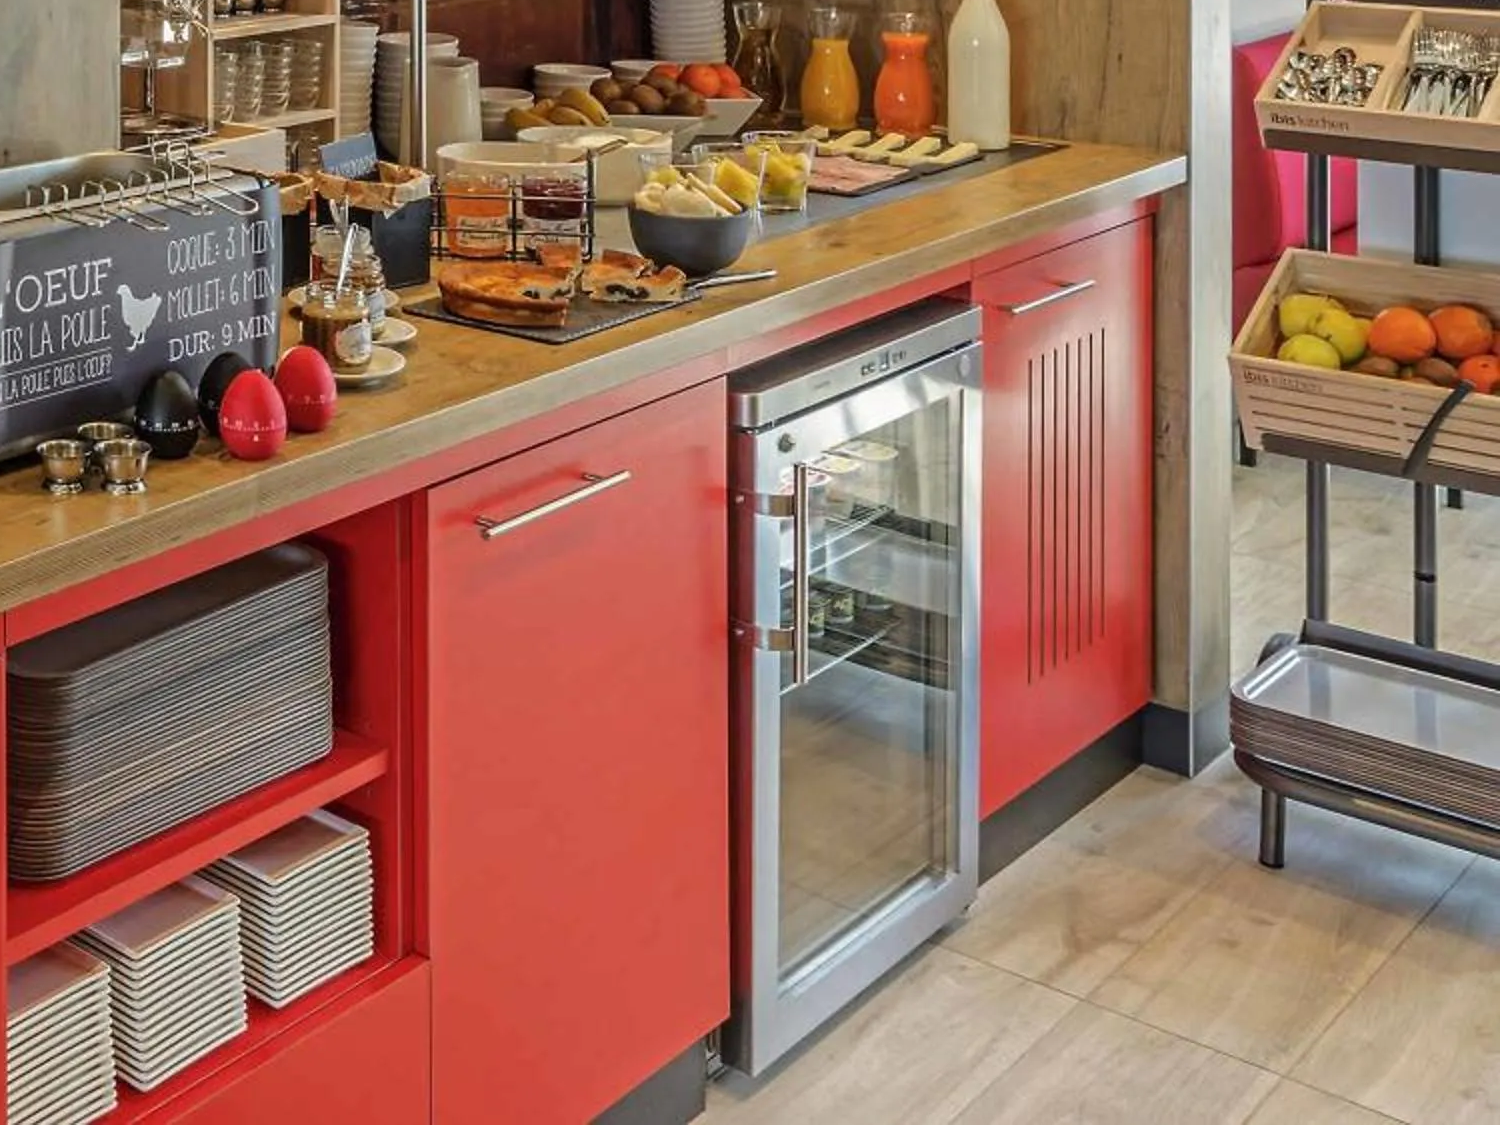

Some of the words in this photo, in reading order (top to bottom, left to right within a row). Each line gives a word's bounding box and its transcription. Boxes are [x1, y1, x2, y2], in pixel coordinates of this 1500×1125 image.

[225, 226, 235, 260] 3
[241, 218, 276, 257] MIN
[229, 274, 239, 306] 6
[243, 264, 276, 303] MIN
[29, 320, 54, 359] LA
[60, 303, 111, 352] POULE
[168, 329, 215, 363] DUR:
[221, 322, 233, 346] 9
[237, 310, 277, 343] MIN
[5, 378, 19, 400] LA
[21, 368, 52, 396] POULE
